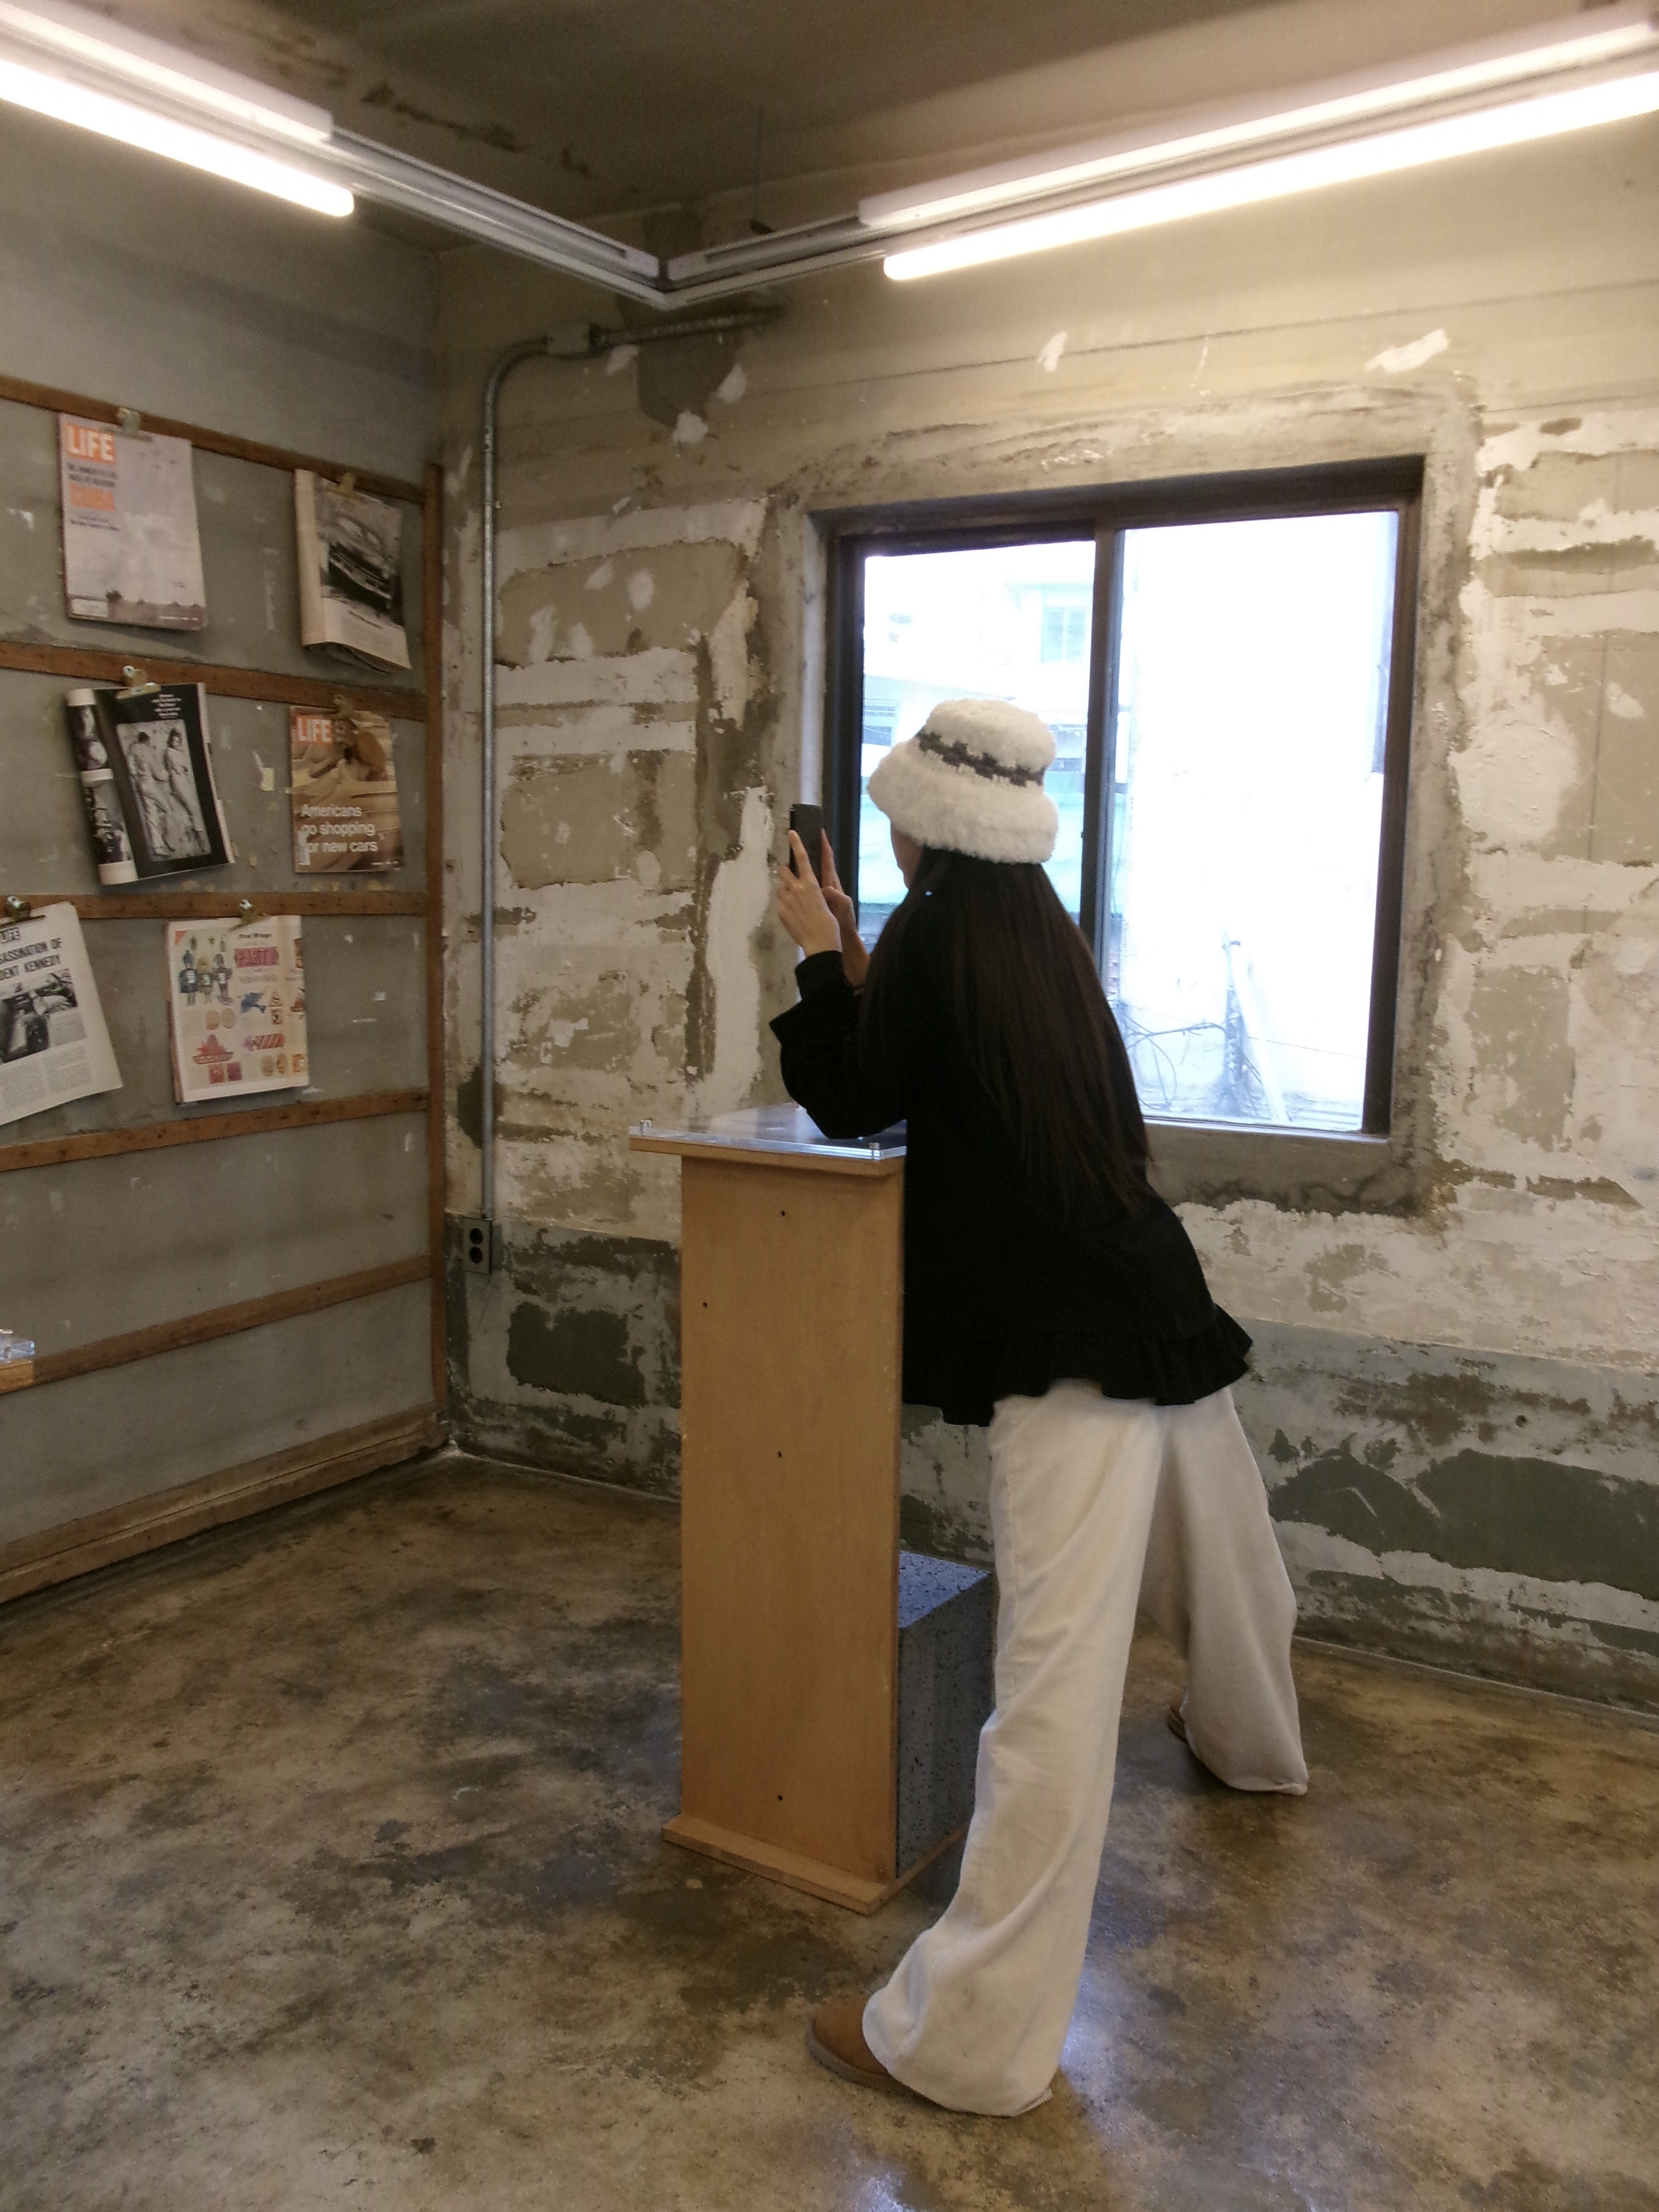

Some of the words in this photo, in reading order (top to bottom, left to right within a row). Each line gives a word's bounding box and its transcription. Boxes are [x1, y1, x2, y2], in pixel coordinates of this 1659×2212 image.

[67, 425, 113, 461] LIFE
[296, 718, 331, 742] LIFE
[301, 804, 362, 817] Americans
[301, 824, 318, 836] go
[319, 821, 376, 837] shopping
[322, 842, 348, 853] new
[349, 841, 379, 852] cars
[50, 937, 62, 949] OF
[24, 954, 61, 973] KENNEDY
